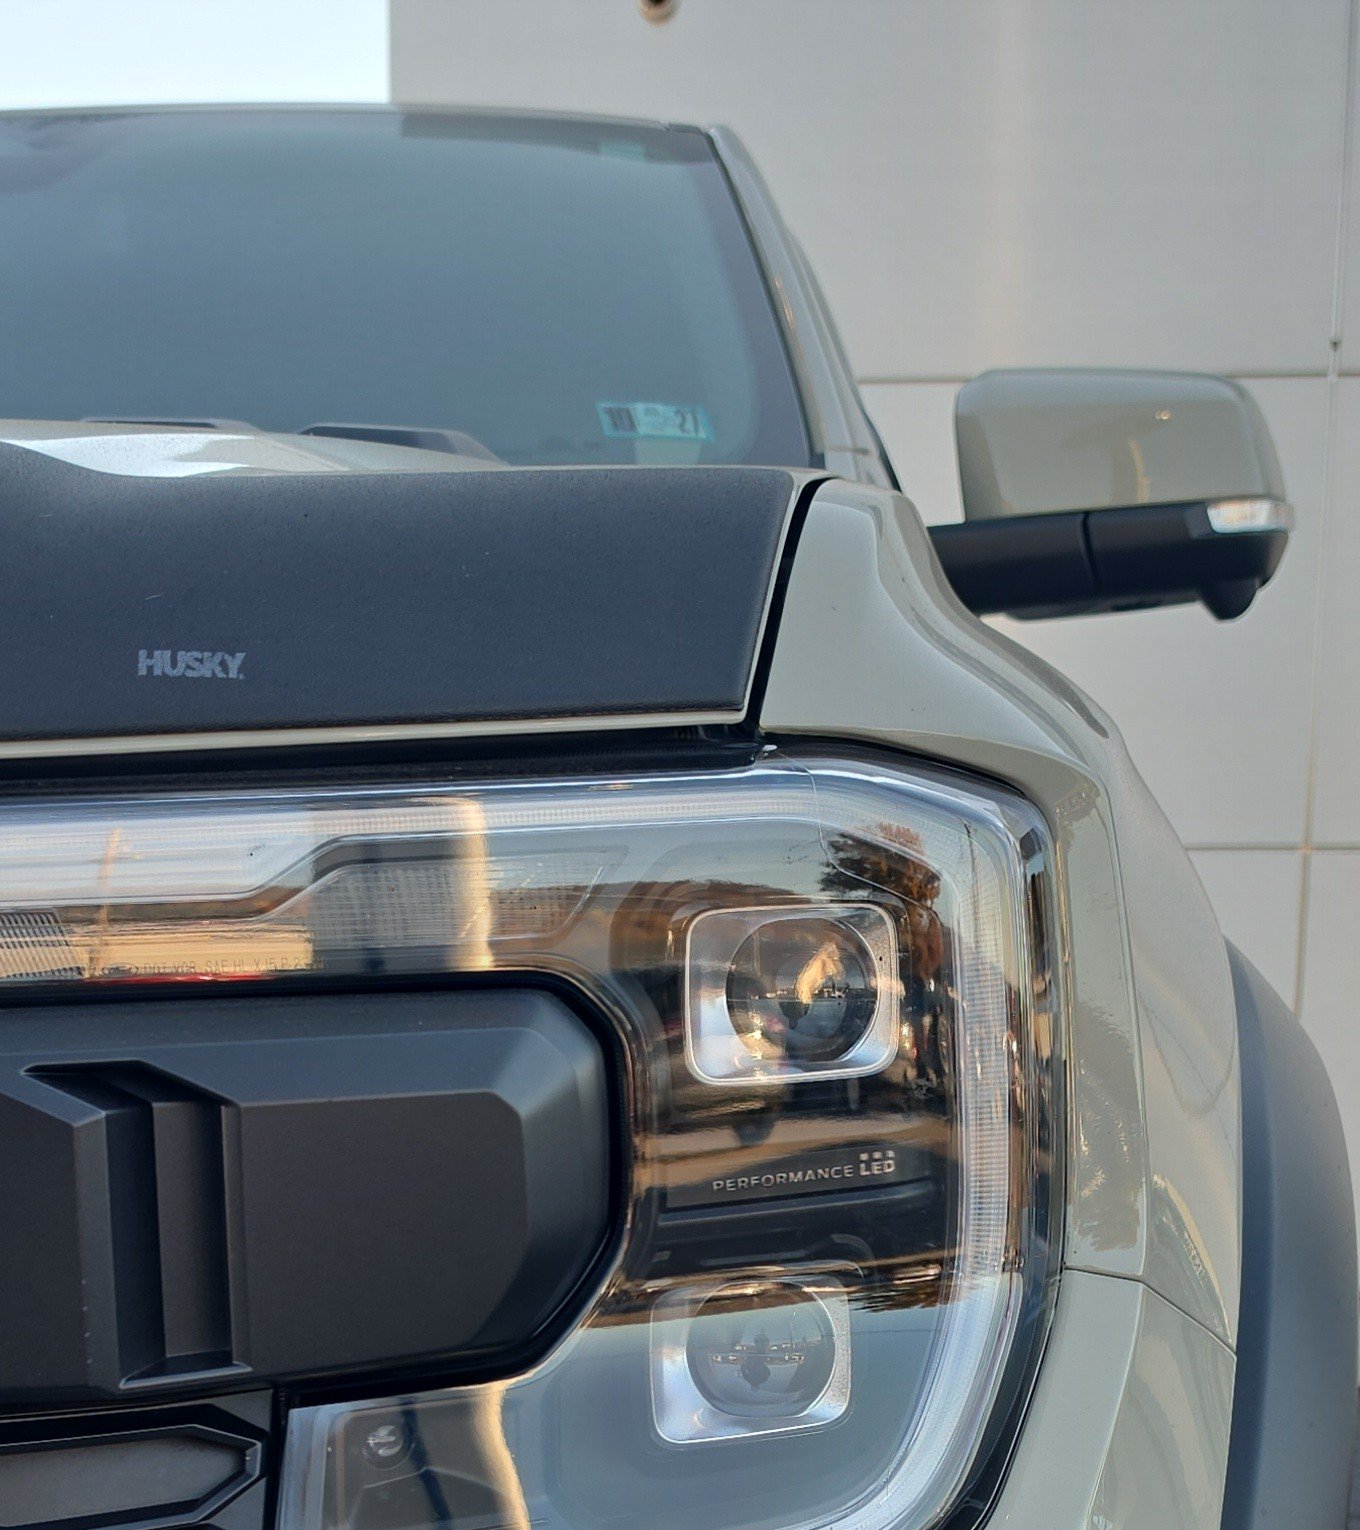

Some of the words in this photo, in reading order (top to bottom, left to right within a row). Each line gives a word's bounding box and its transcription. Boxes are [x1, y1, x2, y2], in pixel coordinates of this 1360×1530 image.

[137, 649, 247, 679] HUSKY
[205, 959, 228, 974] SAE
[712, 1164, 854, 1192] PERFORMANCE
[859, 1160, 896, 1176] LED
